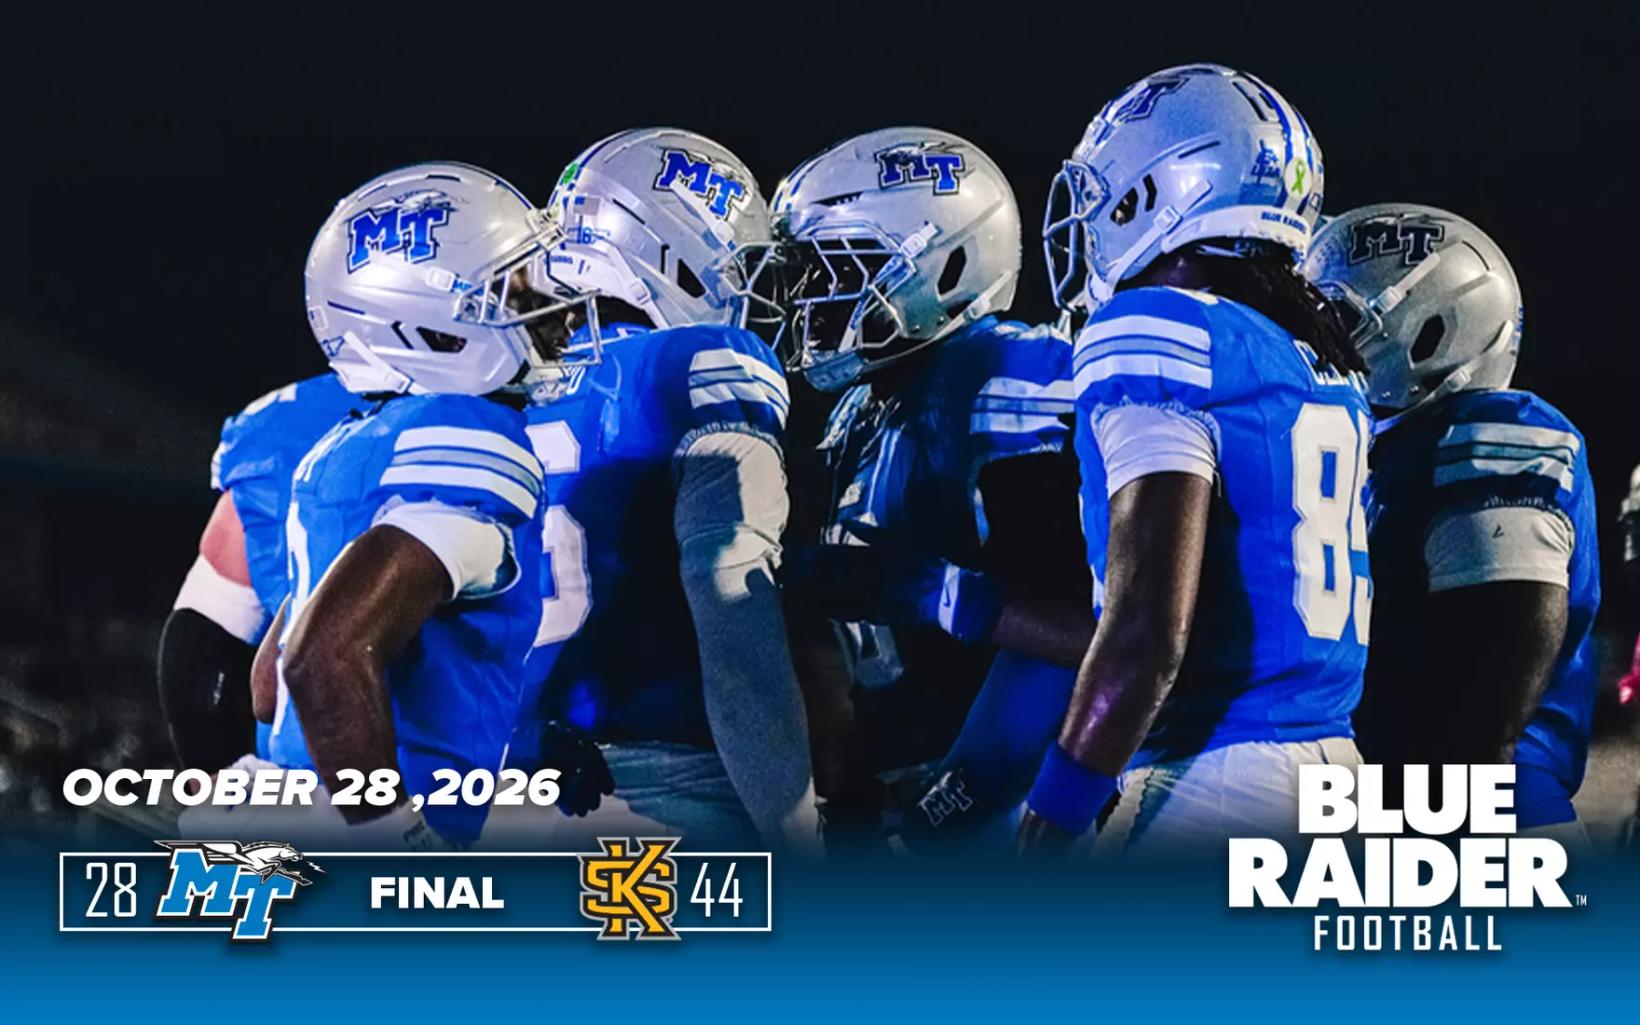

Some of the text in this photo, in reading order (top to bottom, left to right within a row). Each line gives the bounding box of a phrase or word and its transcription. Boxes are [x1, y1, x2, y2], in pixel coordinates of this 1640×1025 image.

[653, 149, 746, 221] MT
[877, 148, 966, 196] MT
[347, 205, 450, 274] MT
[1347, 219, 1445, 268] MT
